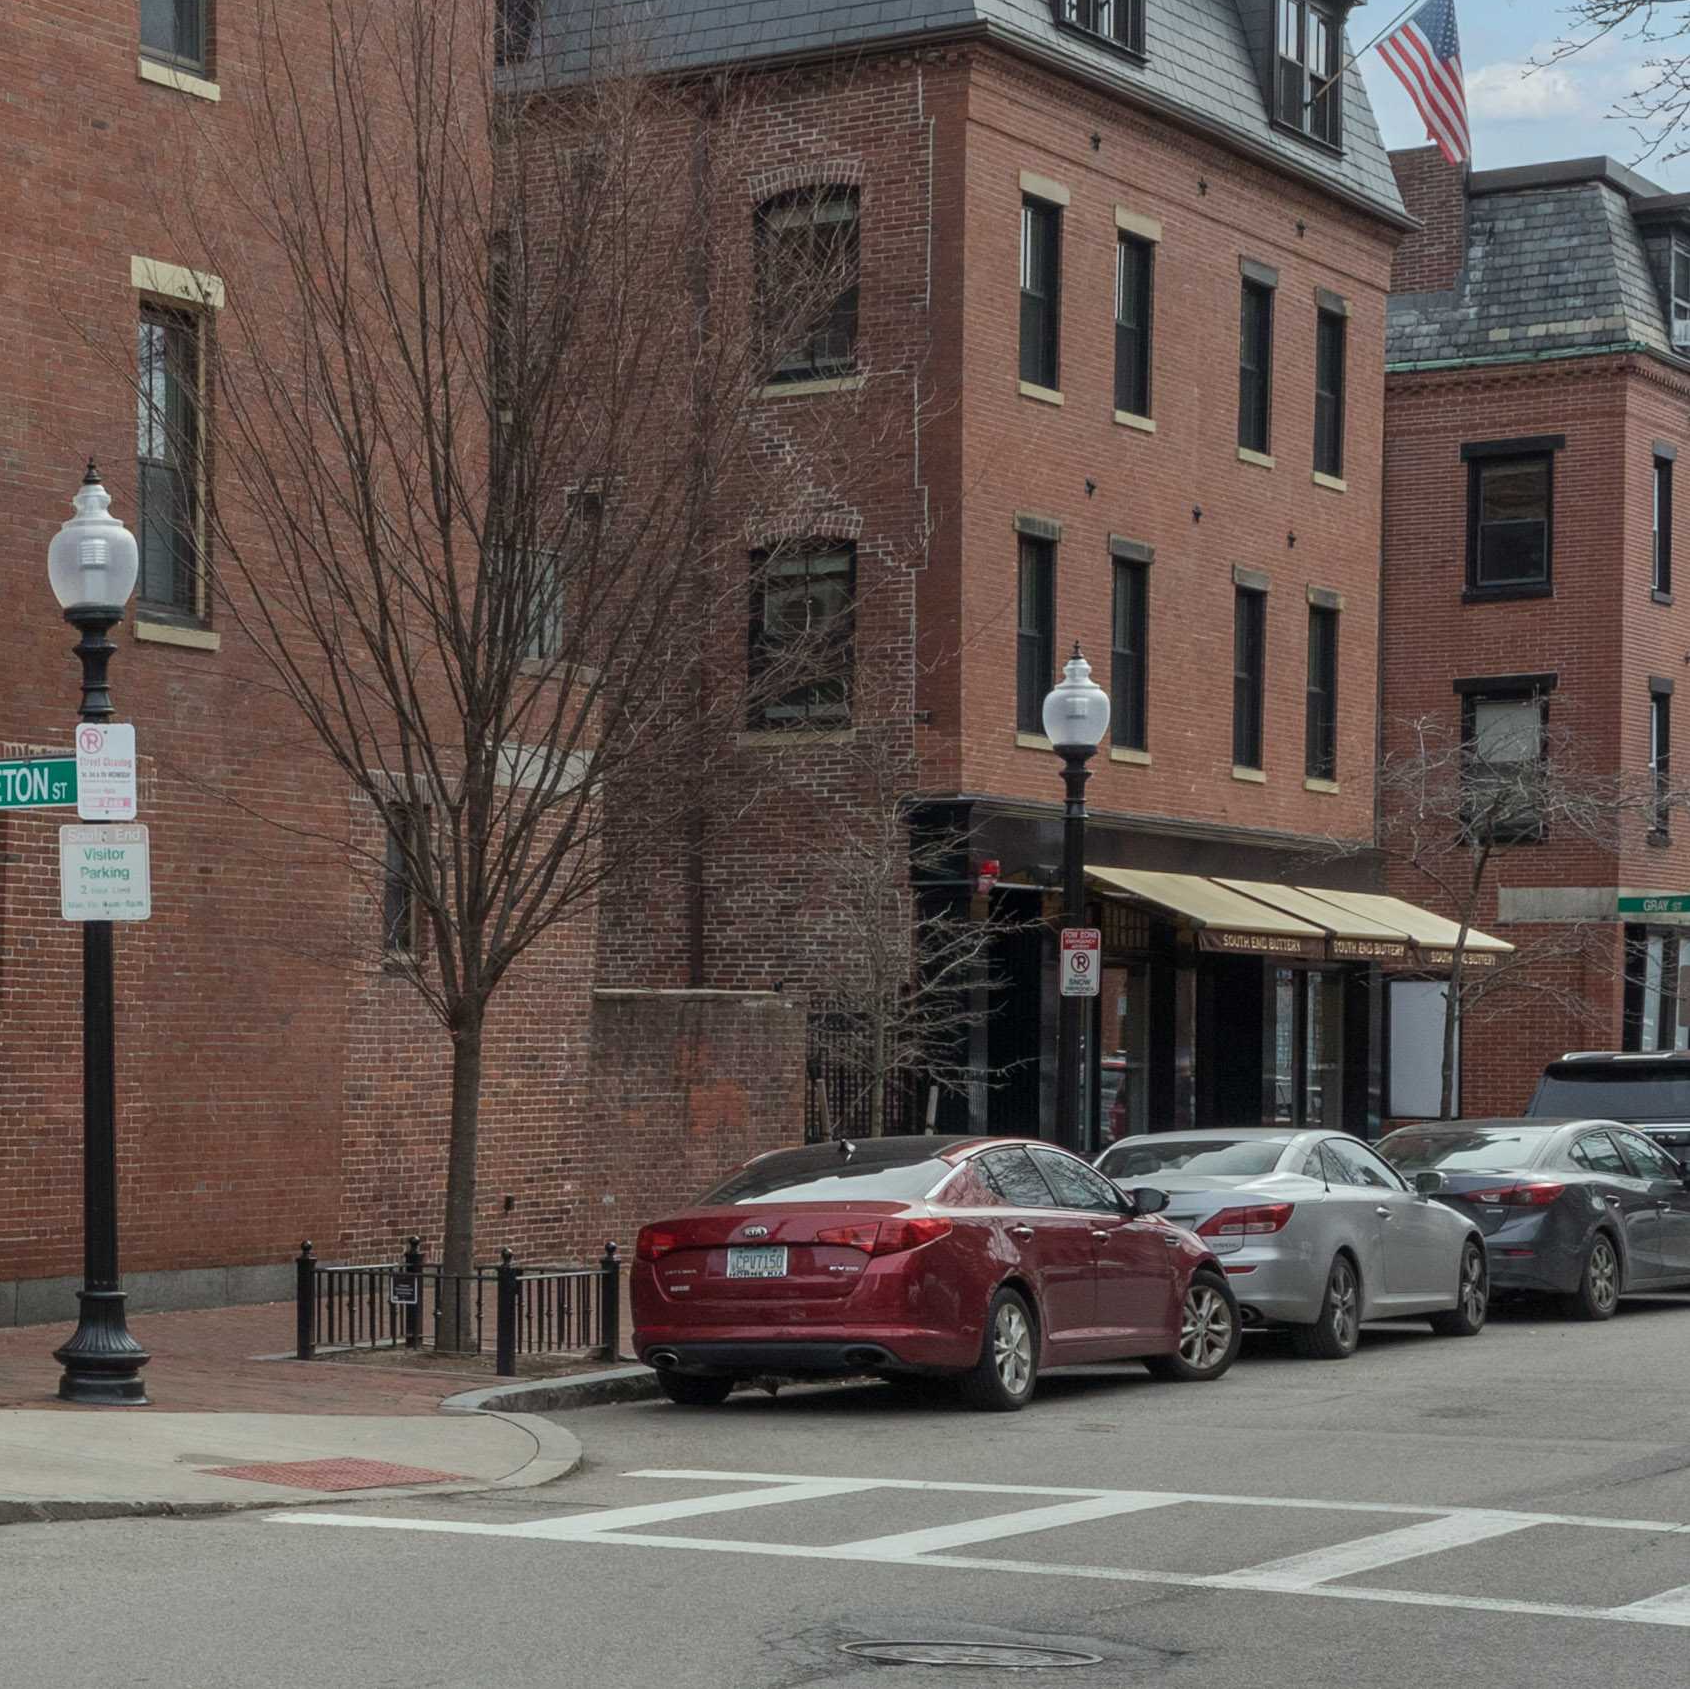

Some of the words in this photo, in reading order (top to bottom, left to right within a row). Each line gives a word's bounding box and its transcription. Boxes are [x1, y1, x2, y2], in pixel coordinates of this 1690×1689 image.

[52, 782, 68, 800] ST
[115, 828, 141, 841] End
[83, 848, 126, 861] Visitor
[80, 866, 130, 881] Parking
[80, 885, 87, 894] 2
[1643, 899, 1669, 911] GRAY
[1672, 902, 1683, 911] ST
[1223, 933, 1250, 949] SOUTH
[1251, 936, 1267, 949] END
[1268, 937, 1301, 953] BUTTERY
[1333, 940, 1357, 954] SOUTH
[736, 1254, 784, 1270] CPV7150
